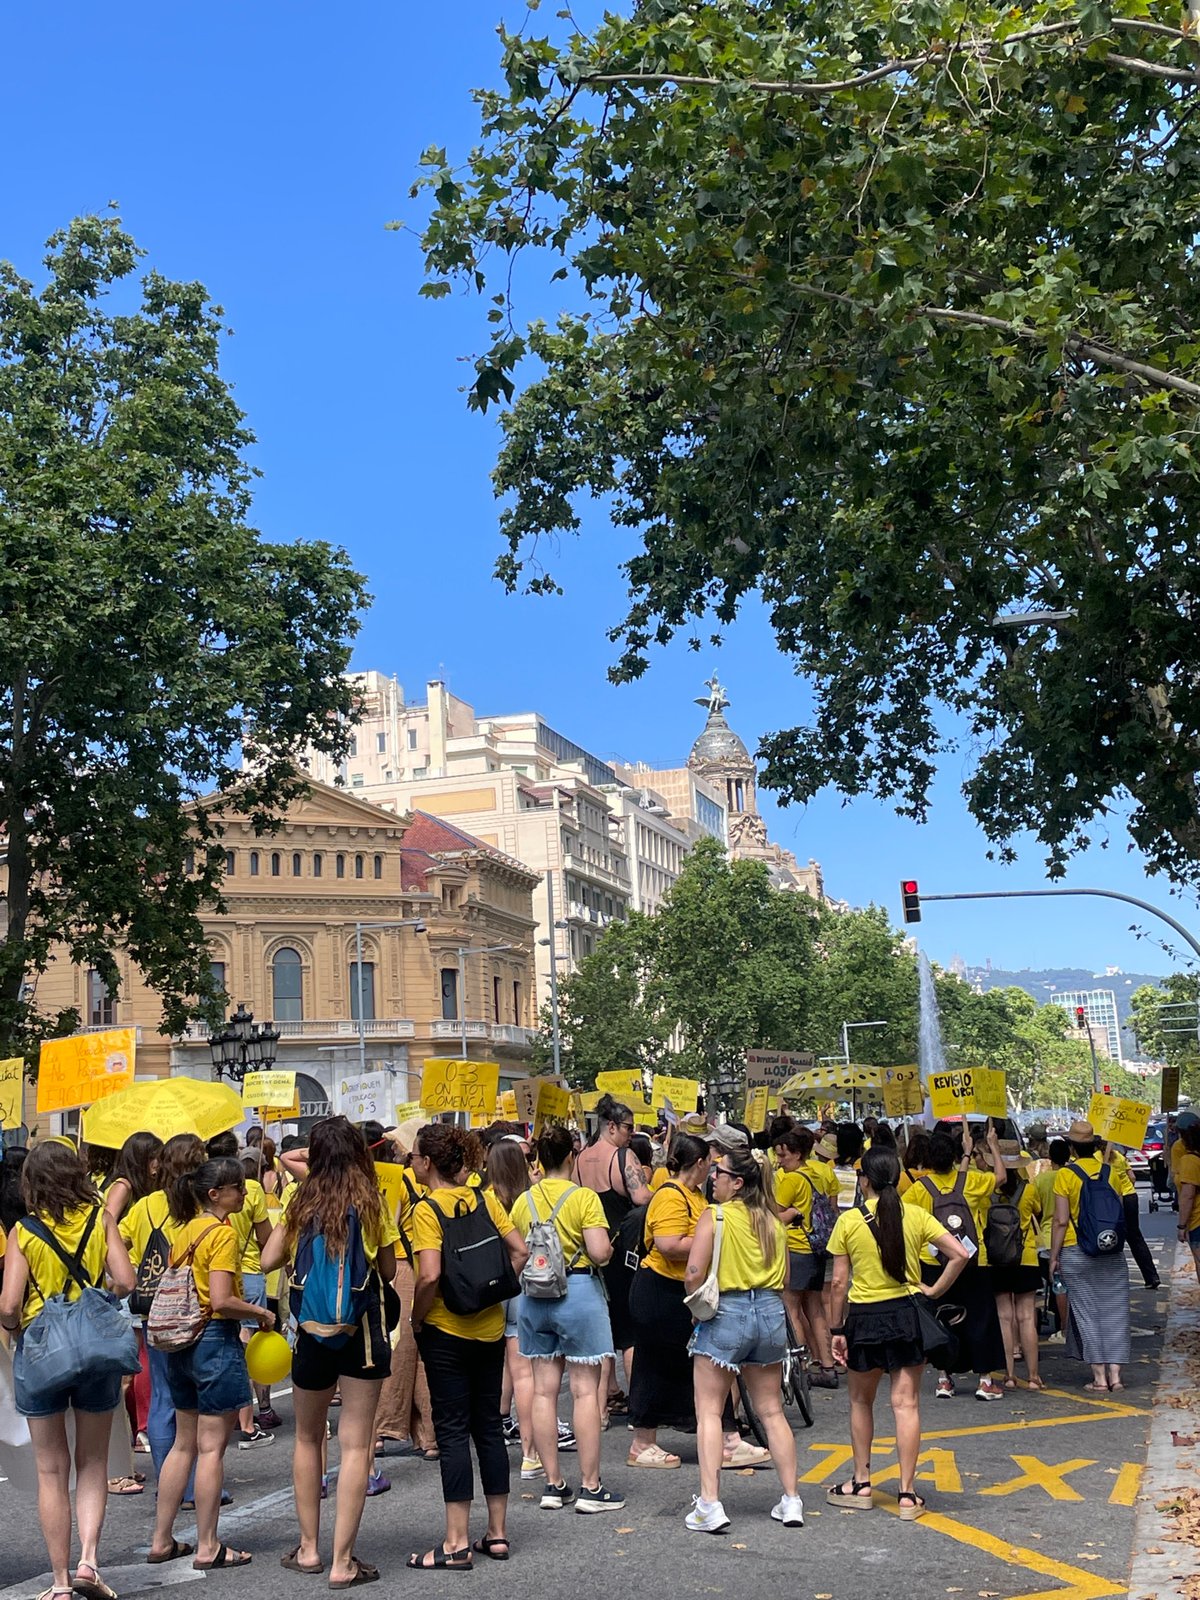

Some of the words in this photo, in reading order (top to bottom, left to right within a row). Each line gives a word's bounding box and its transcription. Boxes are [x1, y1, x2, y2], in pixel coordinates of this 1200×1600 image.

[446, 1061, 479, 1083] 0-3
[897, 1071, 914, 1081] 0-3
[934, 1070, 972, 1090] REVISIÓ
[435, 1082, 451, 1095] ON
[460, 1084, 487, 1096] TOT
[358, 1101, 377, 1114] 0-3
[425, 1095, 486, 1110] COMENÇA
[1103, 1118, 1125, 1133] TOT
[798, 1443, 1143, 1506] TAXI
